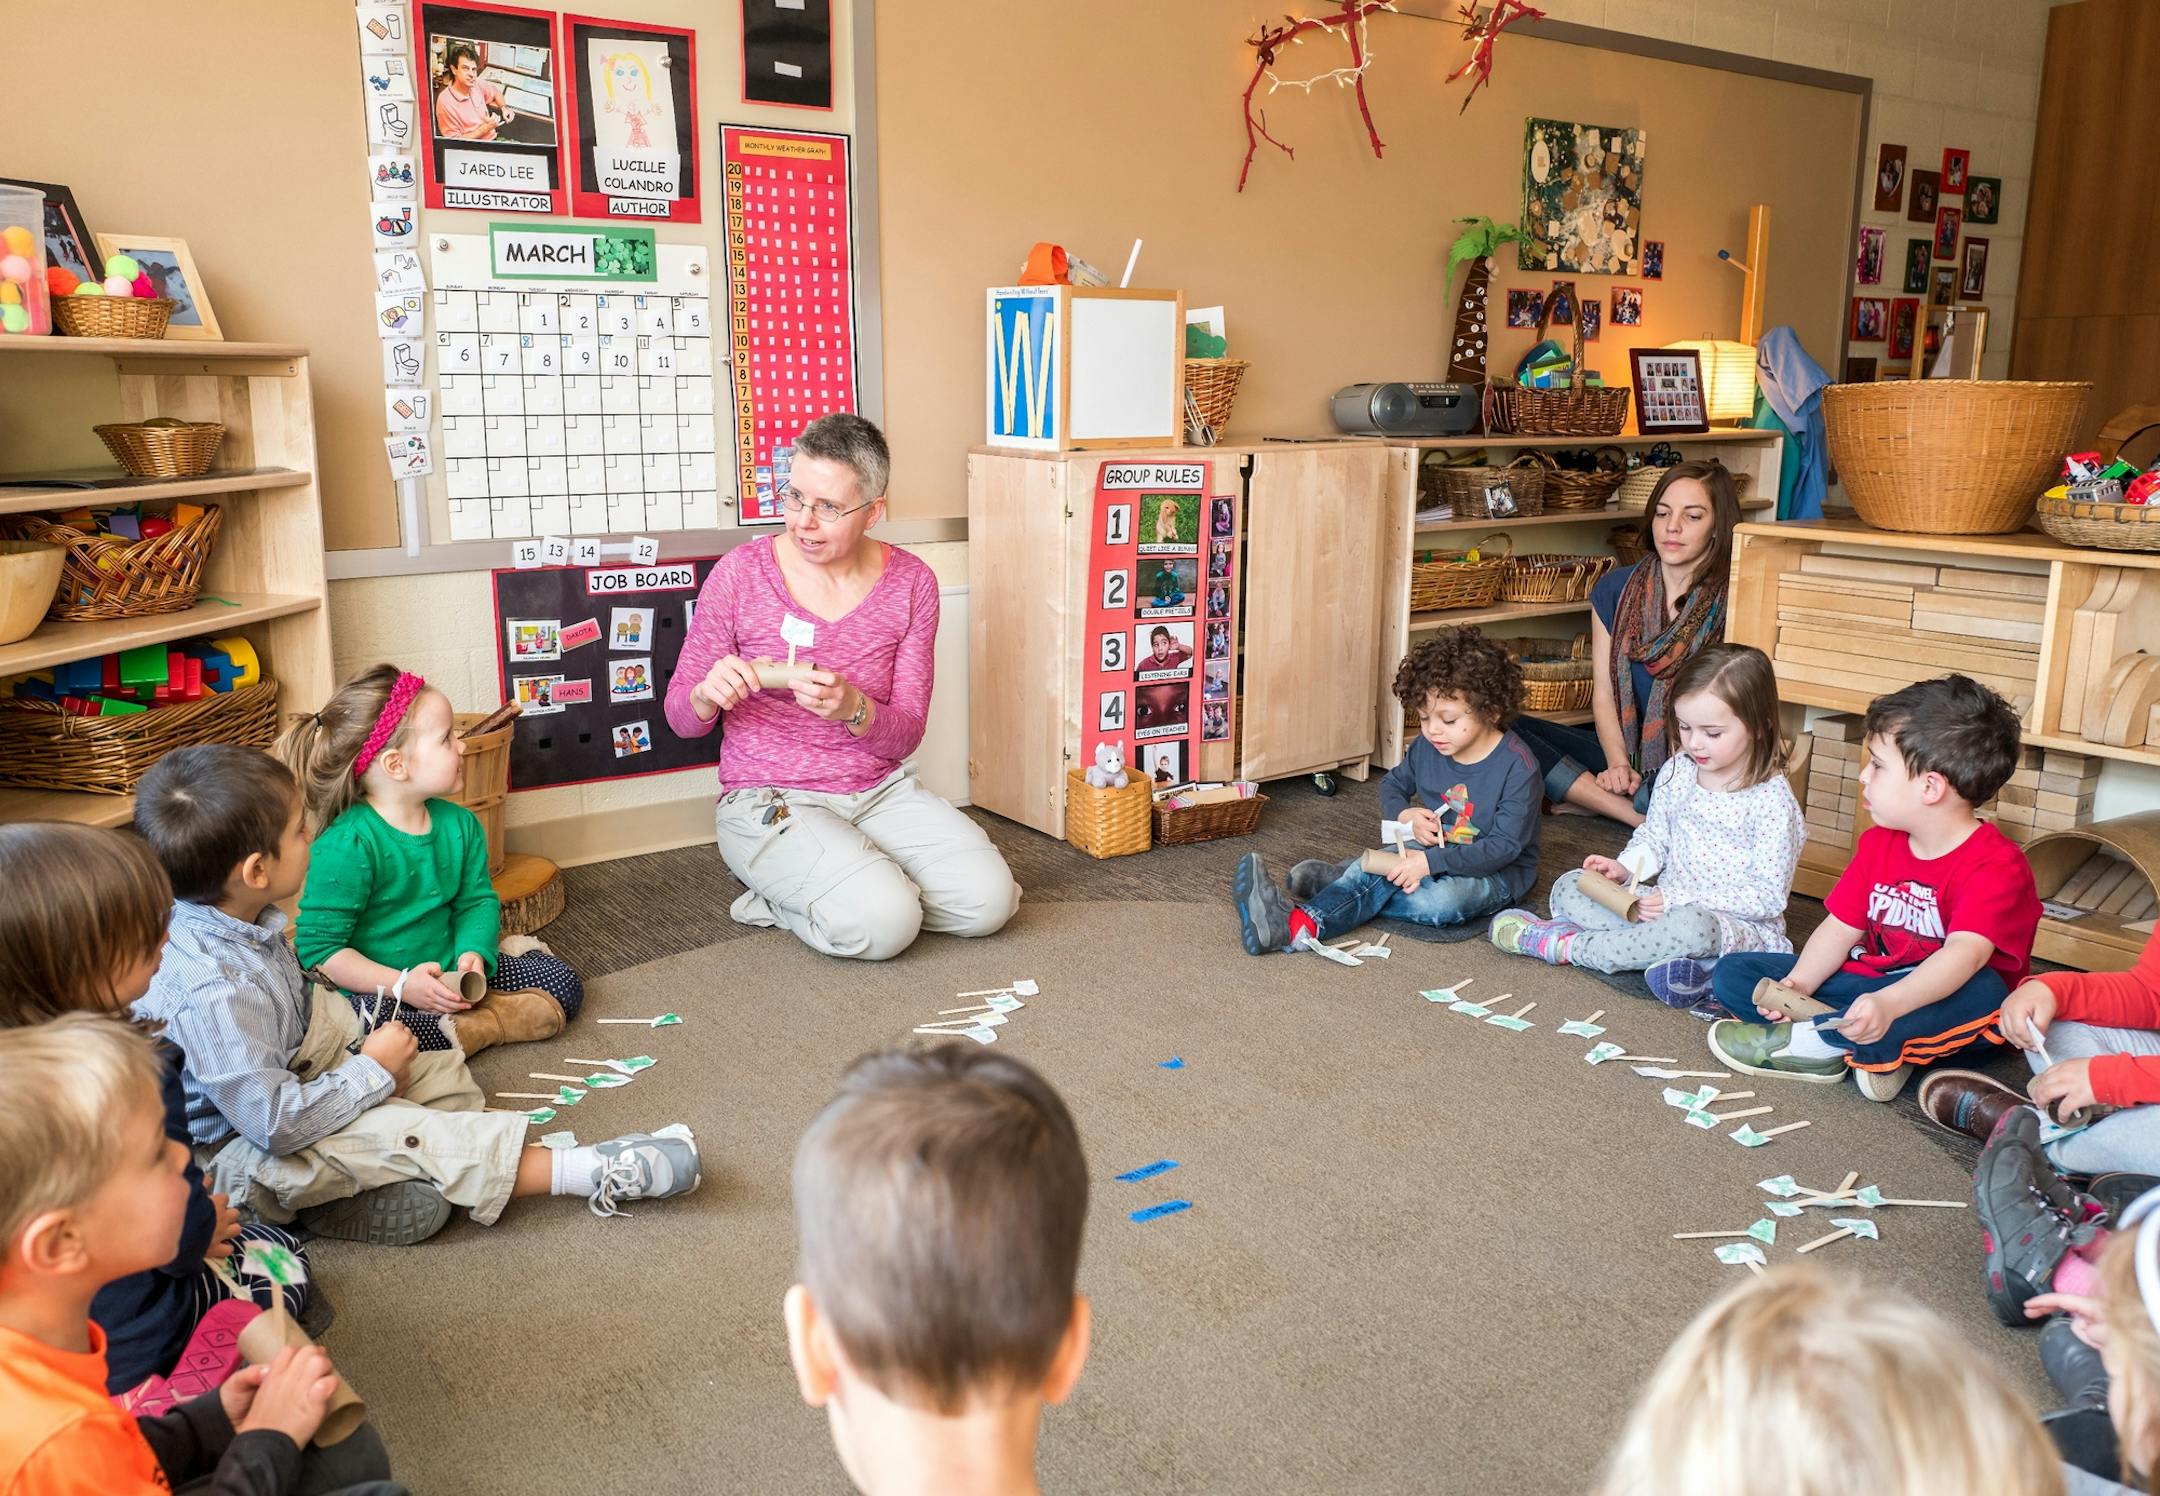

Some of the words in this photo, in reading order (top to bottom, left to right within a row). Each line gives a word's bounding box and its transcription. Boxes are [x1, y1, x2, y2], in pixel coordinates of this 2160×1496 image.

[744, 142, 775, 151] MONTHLY
[776, 143, 806, 154] WEATHER
[459, 162, 505, 178] JARED
[509, 166, 535, 180] LEE
[612, 158, 666, 175] LUCILLE
[727, 163, 742, 175] 20
[604, 177, 674, 193] COLANDRO
[730, 181, 741, 192] 19
[447, 191, 549, 209] ILLUSTRATOR
[730, 198, 742, 210] 18
[611, 202, 667, 215] AUTHOR
[731, 216, 742, 227] 17
[732, 233, 744, 244] 16
[505, 242, 586, 264] MARCH
[733, 250, 744, 261] 15
[733, 267, 745, 278] 14
[734, 284, 746, 295] 13
[560, 295, 571, 307] 2
[673, 297, 681, 307] 5
[735, 301, 746, 312] 12
[541, 313, 547, 326] 1
[580, 316, 588, 329] 2
[621, 317, 629, 330] 3
[656, 317, 665, 329] 4
[691, 315, 700, 327] 5
[736, 318, 745, 329] 11
[439, 333, 446, 343] 6
[482, 334, 490, 345] 7
[736, 335, 748, 347] 10
[460, 348, 469, 362] 6
[499, 353, 509, 366] 7
[543, 354, 551, 367] 8
[581, 351, 590, 364] 9
[614, 354, 629, 368] 10
[658, 356, 670, 368] 11
[739, 352, 746, 364] 9
[739, 369, 747, 380] 8
[742, 386, 747, 397] 7
[743, 403, 750, 414] 6
[744, 419, 751, 430] 5
[743, 435, 750, 446] 4
[745, 452, 752, 462] 3
[746, 468, 752, 479] 2
[1106, 469, 1151, 484] GROUP
[1154, 469, 1201, 484] RULES
[747, 485, 752, 495] 1
[1111, 508, 1122, 539] 1
[520, 547, 536, 561] 15
[549, 543, 564, 557] 13
[580, 545, 596, 558] 14
[638, 544, 653, 557] 12
[591, 575, 628, 591] JOB
[635, 570, 692, 587] BOARD
[1108, 574, 1125, 604] 2
[566, 627, 593, 641] DAKOTA
[1104, 638, 1121, 667] 3
[558, 687, 584, 698] HANS
[1104, 695, 1123, 725] 4
[1136, 729, 1150, 738] EYES
[1162, 725, 1186, 734] TEACHER
